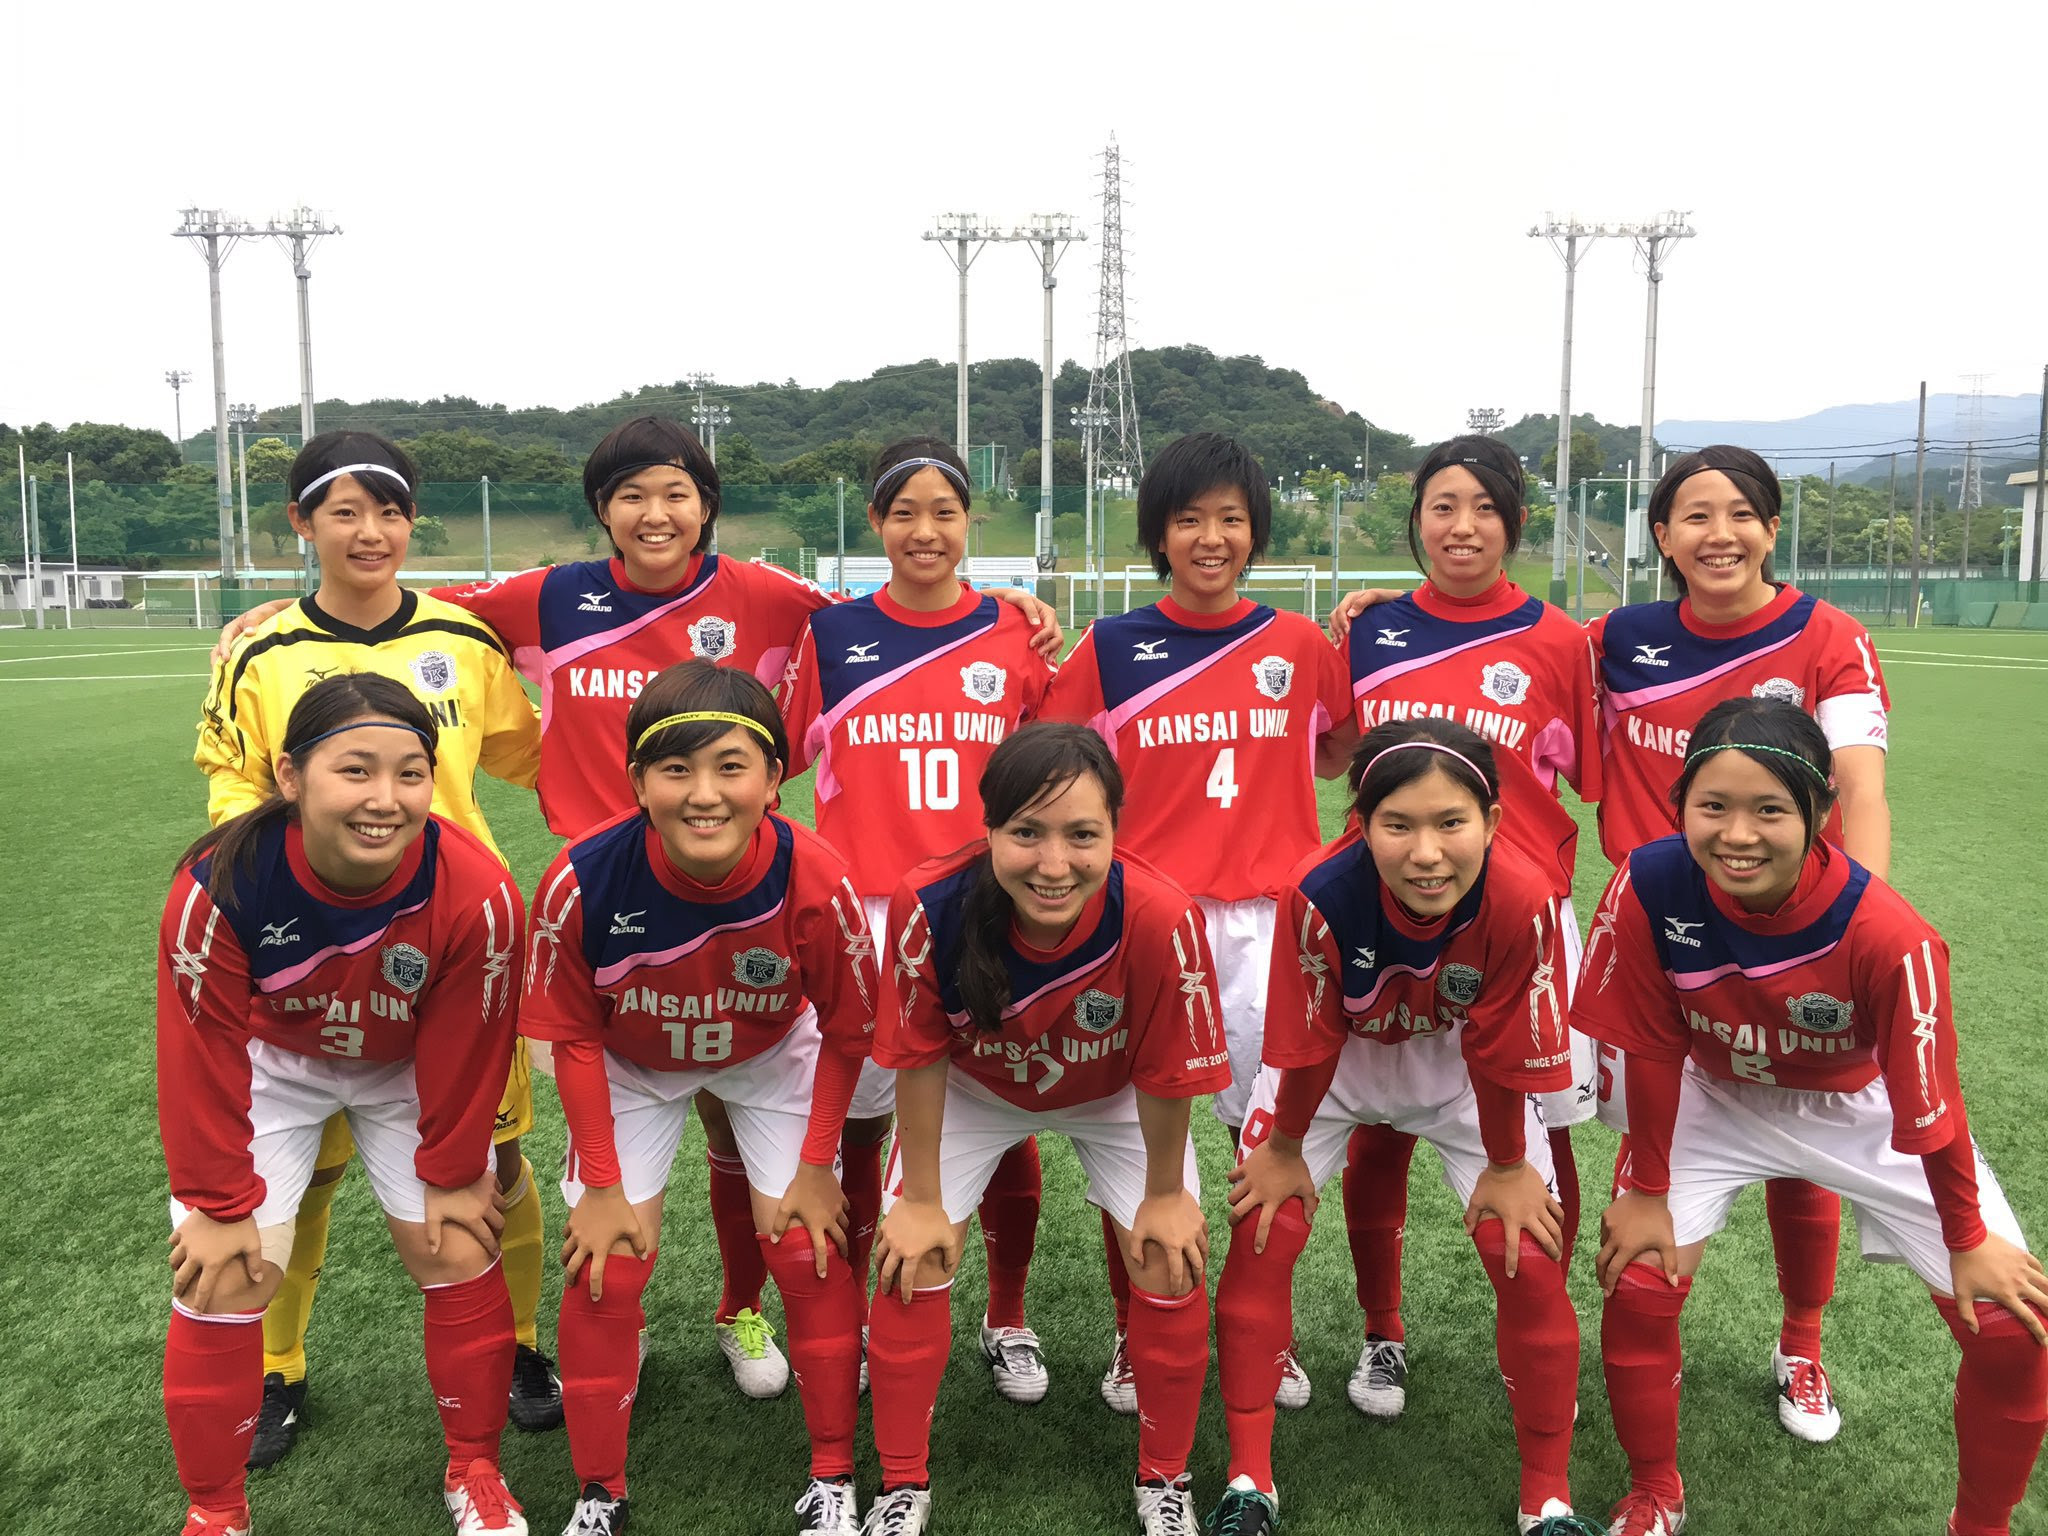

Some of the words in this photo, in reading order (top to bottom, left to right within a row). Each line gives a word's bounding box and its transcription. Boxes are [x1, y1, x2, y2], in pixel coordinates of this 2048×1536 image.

[577, 602, 613, 613] MIZUNO
[706, 635, 720, 649] K
[1375, 637, 1408, 648] MIZUNO
[845, 654, 880, 664] MIZUNO
[1133, 652, 1169, 662] MIZUNO
[1631, 654, 1670, 668] MIZUNO
[846, 712, 943, 746] KANSAI
[1136, 710, 1238, 748] KANSAI
[1249, 708, 1289, 738] UNIV.
[899, 748, 960, 810] 10
[1206, 747, 1239, 809] 4
[608, 925, 645, 934] MIZUNO
[1664, 928, 1702, 948] MIZUNO
[258, 934, 300, 948] MIZUNO
[270, 990, 361, 1022] ANAI
[716, 986, 791, 1013] UNIV.
[320, 1025, 365, 1057] 3
[661, 1021, 733, 1062] 18
[1185, 1056, 1209, 1071] SINCE
[1209, 1050, 1229, 1066] 2013
[1524, 1057, 1551, 1069] SINCE
[1551, 1049, 1571, 1066] 2013
